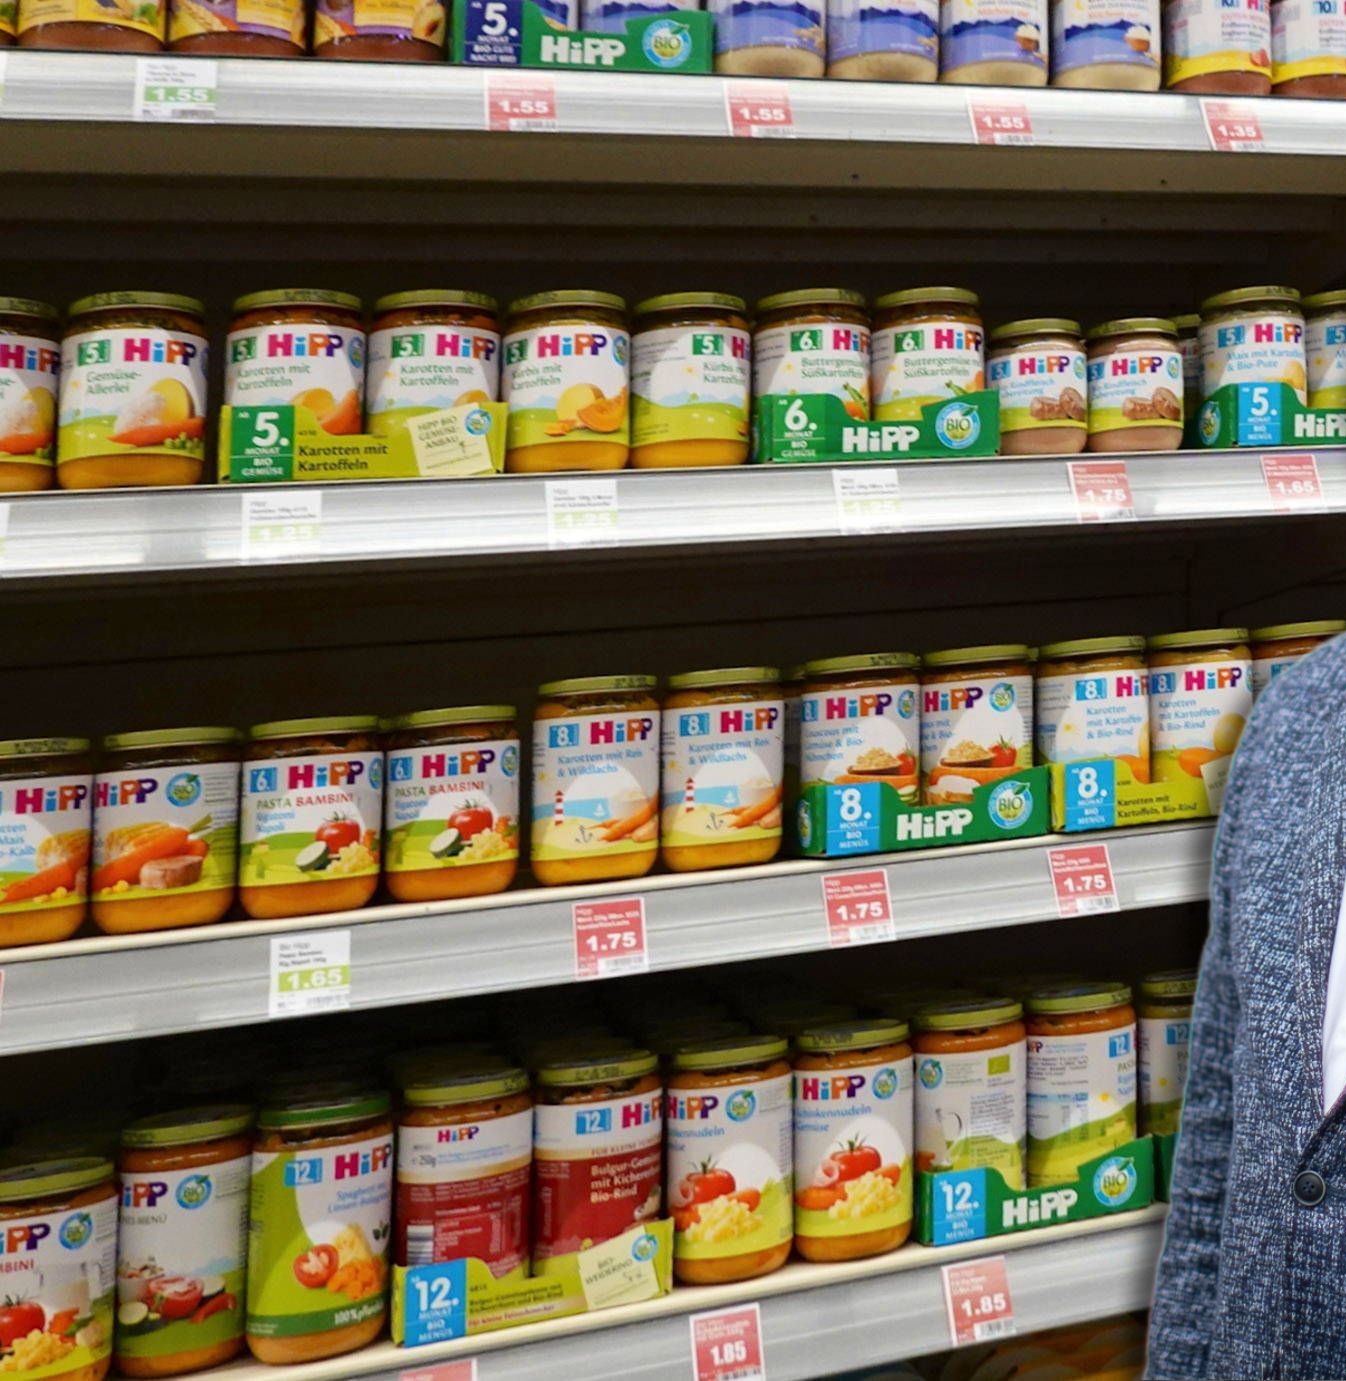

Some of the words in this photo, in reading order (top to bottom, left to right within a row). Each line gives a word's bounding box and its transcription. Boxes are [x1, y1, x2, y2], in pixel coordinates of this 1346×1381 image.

[482, 2, 518, 36] 5.
[541, 36, 626, 65] HiPP
[654, 37, 680, 49] BIO
[151, 87, 207, 102] 1.55
[499, 101, 548, 113] 1.55
[739, 107, 785, 121] 1.55
[982, 115, 1024, 129] 1.55
[1216, 126, 1257, 138] 1.35
[934, 329, 981, 351] HiPP
[1255, 324, 1302, 343] HiPP
[124, 338, 196, 366] HiPP
[268, 334, 343, 357] HiPP
[436, 334, 496, 360] HiPP
[537, 334, 607, 358] HiPP
[236, 364, 285, 378] Karotten
[289, 364, 311, 374] mit
[399, 364, 452, 375] Karotten
[455, 365, 474, 374] mit
[1019, 356, 1070, 375] HiPP
[1112, 357, 1163, 376] HiPP
[86, 369, 142, 382] Gemüse-
[236, 377, 293, 391] Kartoffeln
[399, 375, 459, 386] Kartoffeln
[86, 383, 130, 394] Allerlei
[1251, 387, 1277, 416] 5.
[784, 399, 817, 431] 6.
[252, 412, 289, 447] 5.
[946, 418, 970, 432] BIO
[842, 426, 920, 453] HiPP
[244, 447, 281, 455] MONAT
[298, 445, 362, 457] Karotten
[365, 445, 387, 454] mit
[253, 457, 273, 466] BIO
[298, 459, 368, 472] Kartoffeln
[1276, 480, 1315, 495] 1.65
[1184, 667, 1242, 691] HiPP
[826, 693, 892, 720] HiPP
[924, 687, 983, 713] HiPP
[720, 707, 778, 733] HiPP
[1086, 705, 1127, 716] Karotten
[590, 718, 653, 745] HiPP
[1097, 727, 1134, 738] Bio-Rind
[1167, 720, 1206, 730] Bio-Rind
[688, 741, 734, 752] Karotten
[735, 740, 752, 748] mit
[422, 750, 495, 779] HiPP
[557, 751, 601, 765] Karotten
[604, 750, 622, 759] mit
[688, 756, 695, 764] &
[699, 752, 747, 765] Wildlachs
[288, 761, 364, 789] HiPP
[557, 767, 565, 777] &
[568, 763, 618, 777] Wildlachs
[394, 786, 425, 797] PASTA
[429, 781, 485, 795] BAMBINI
[1078, 766, 1108, 799] 8.
[15, 785, 87, 814] HiPP
[95, 778, 158, 808] HiPP
[256, 797, 292, 810] PASTA
[295, 793, 354, 808] BAMBINI
[1117, 796, 1153, 806] Karotten
[1156, 794, 1169, 802] mit
[840, 788, 872, 822] 8.
[999, 798, 1024, 812] BIO
[1117, 806, 1159, 818] Kartoffeln,
[1162, 802, 1197, 813] Bio-Rind
[897, 808, 973, 840] HiPP
[845, 830, 862, 839] BIO
[1063, 874, 1107, 893] 1.75
[836, 900, 884, 921] 1.75
[585, 931, 637, 952] 1.75
[286, 968, 343, 990] 1.65
[802, 1075, 866, 1100] HiPP
[669, 1096, 718, 1120] HiPP
[437, 1125, 479, 1143] HiPP
[334, 1144, 391, 1180] HiPP
[591, 1178, 610, 1189] mit
[1103, 1173, 1127, 1189] BIO
[591, 1186, 638, 1203] Bio-Rind
[941, 1182, 979, 1214] 12.
[1003, 1189, 1078, 1228] HiPP
[952, 1220, 968, 1229] BIO
[414, 1277, 459, 1310] 12.
[961, 1293, 1007, 1317] 1.85
[427, 1320, 445, 1329] BIO
[710, 1340, 747, 1366] 1.85
